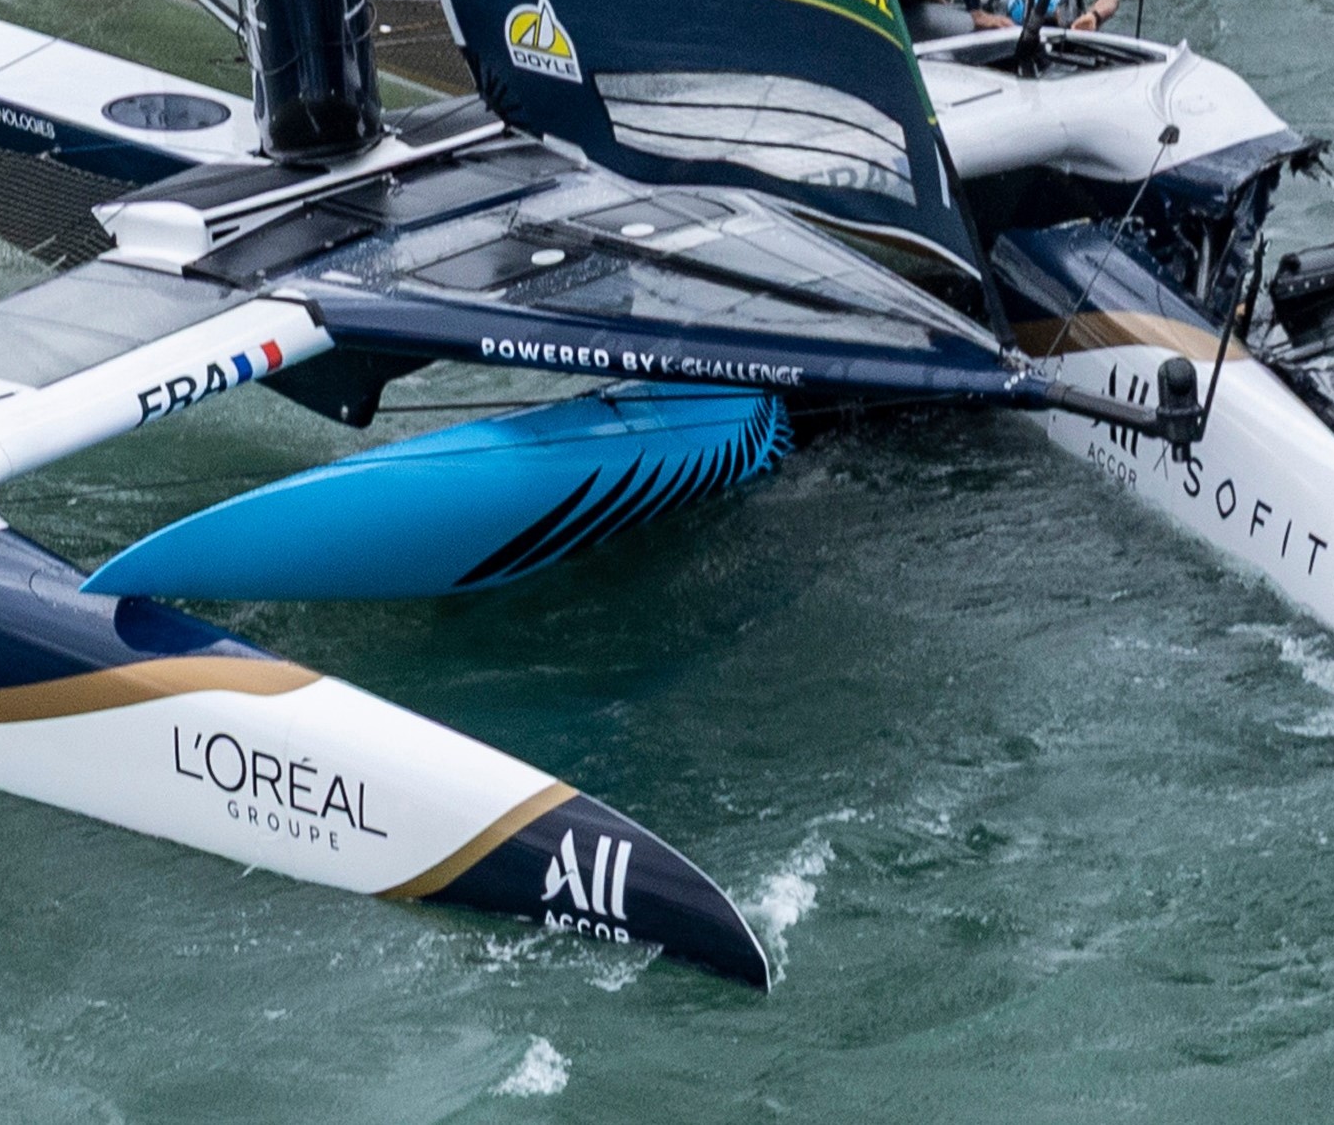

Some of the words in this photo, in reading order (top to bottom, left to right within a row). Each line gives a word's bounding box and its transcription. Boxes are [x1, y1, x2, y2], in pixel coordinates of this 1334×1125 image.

[513, 50, 579, 78] DOYLE
[481, 337, 610, 368] POWERED
[622, 351, 655, 373] BY
[136, 360, 228, 428] FRA
[1087, 442, 1138, 493] ACCOR
[173, 725, 388, 839] L'ORÉAL
[227, 799, 340, 852] GROUPE
